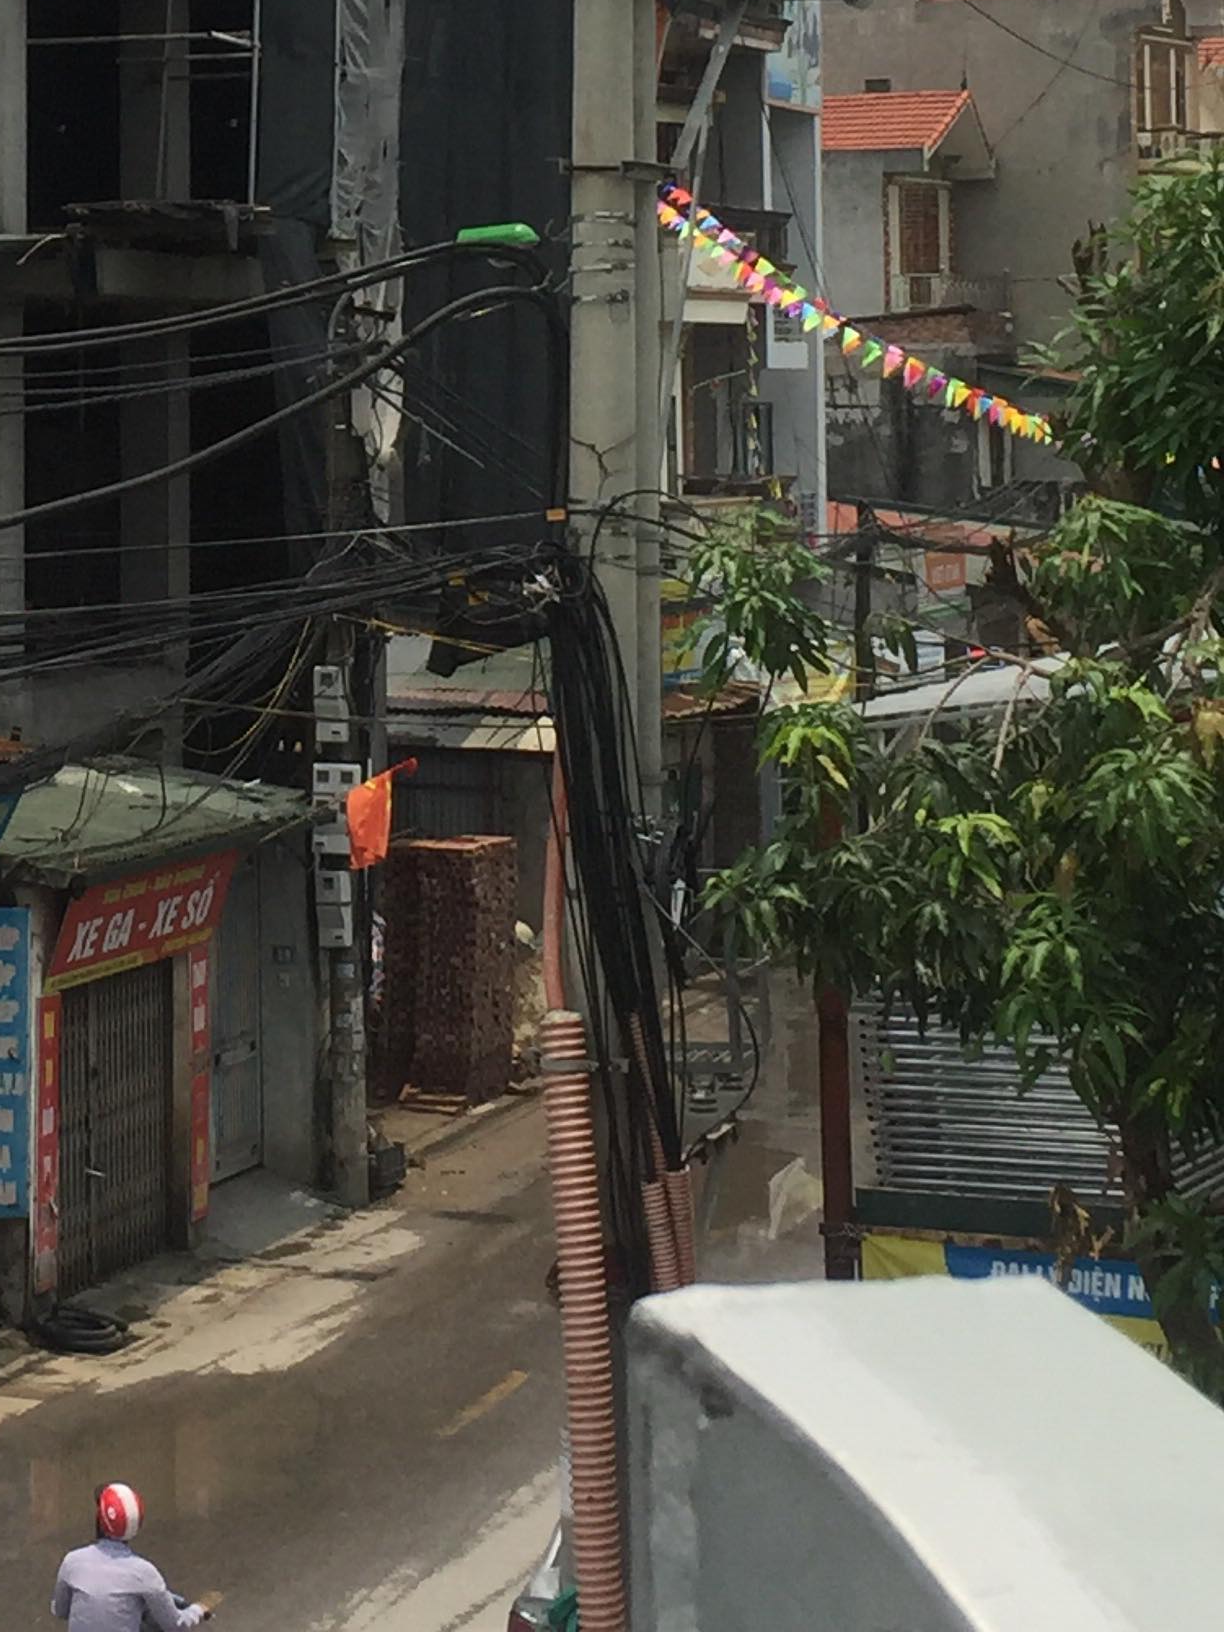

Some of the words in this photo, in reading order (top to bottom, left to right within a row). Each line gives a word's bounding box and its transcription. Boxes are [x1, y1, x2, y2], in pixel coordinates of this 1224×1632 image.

[66, 916, 103, 963] XE
[102, 908, 135, 953] GA
[148, 893, 184, 940] XE
